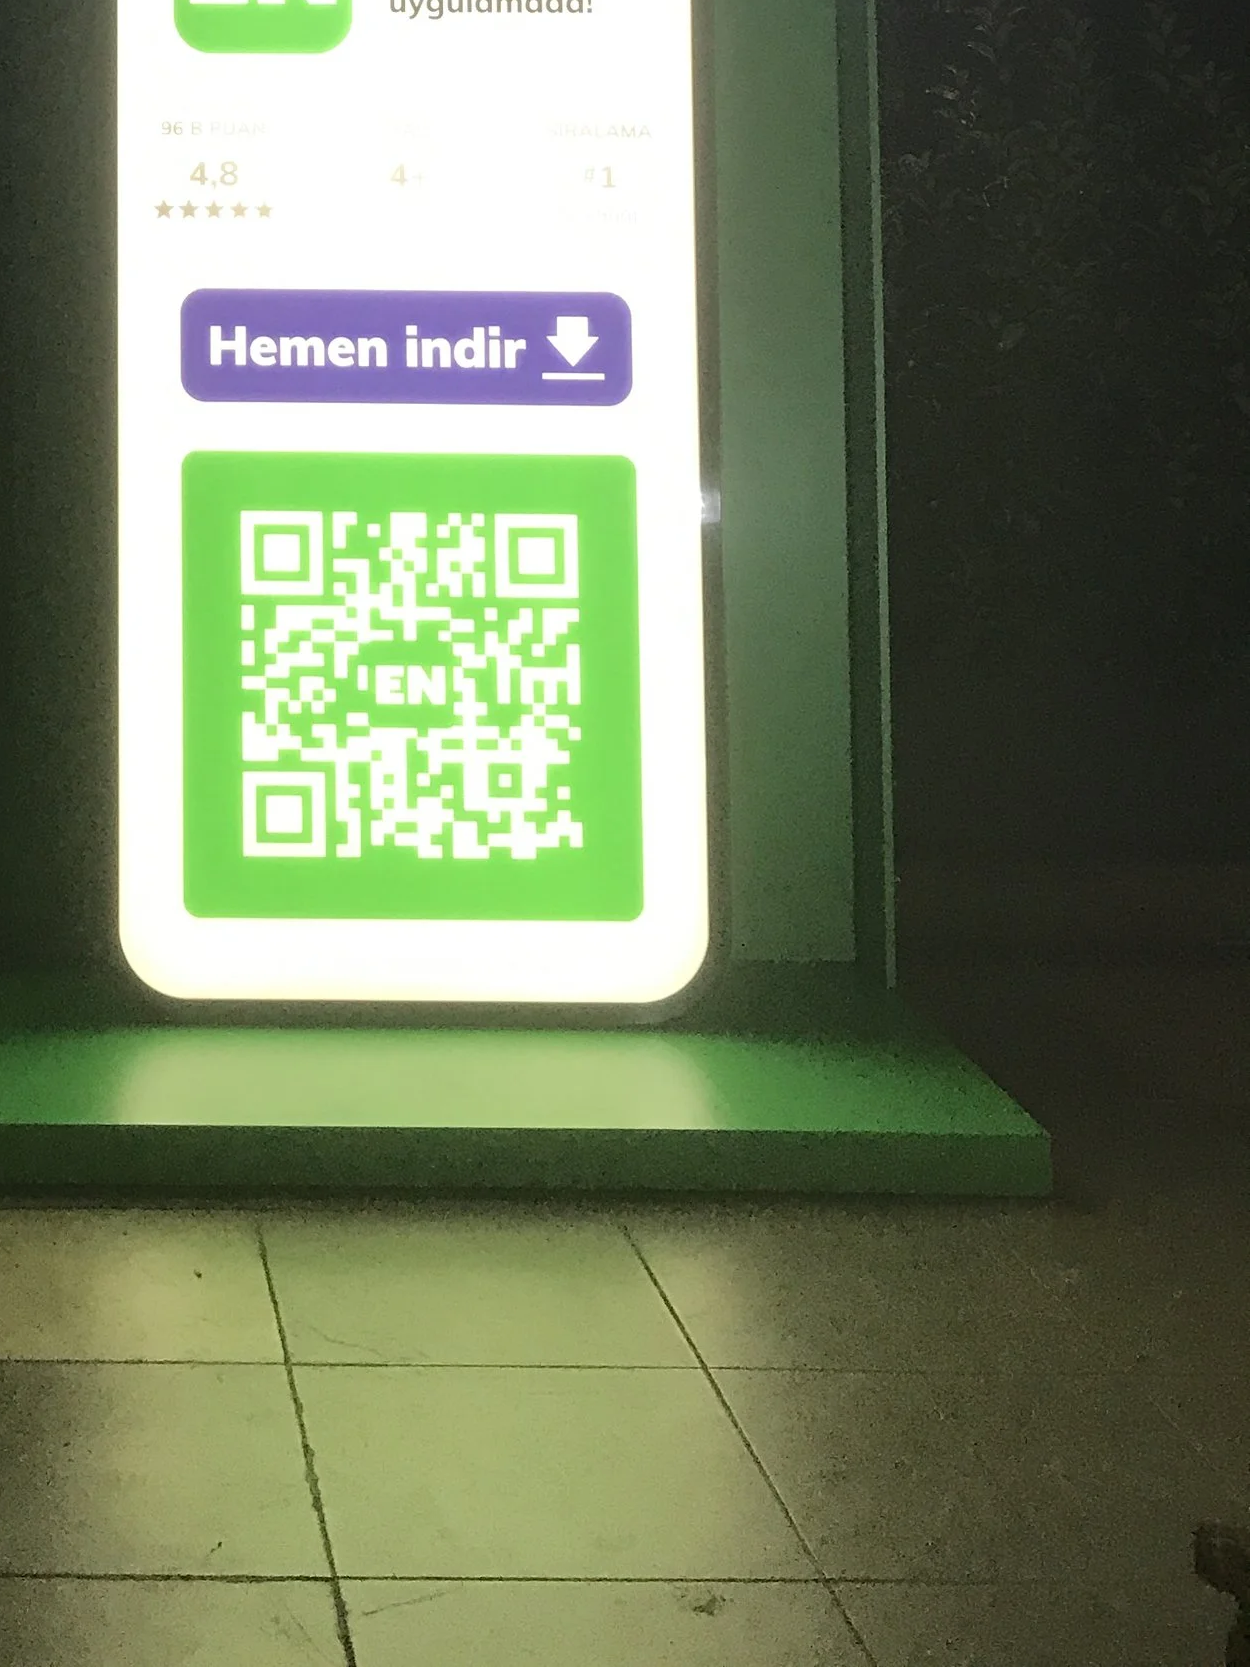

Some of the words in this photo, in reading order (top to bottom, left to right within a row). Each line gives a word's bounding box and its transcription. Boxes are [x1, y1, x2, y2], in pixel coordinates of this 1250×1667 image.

[161, 120, 184, 136] 96
[190, 161, 239, 190] 4,8
[209, 325, 388, 368] Hemen
[406, 325, 526, 369] indir
[375, 664, 446, 705] EN
